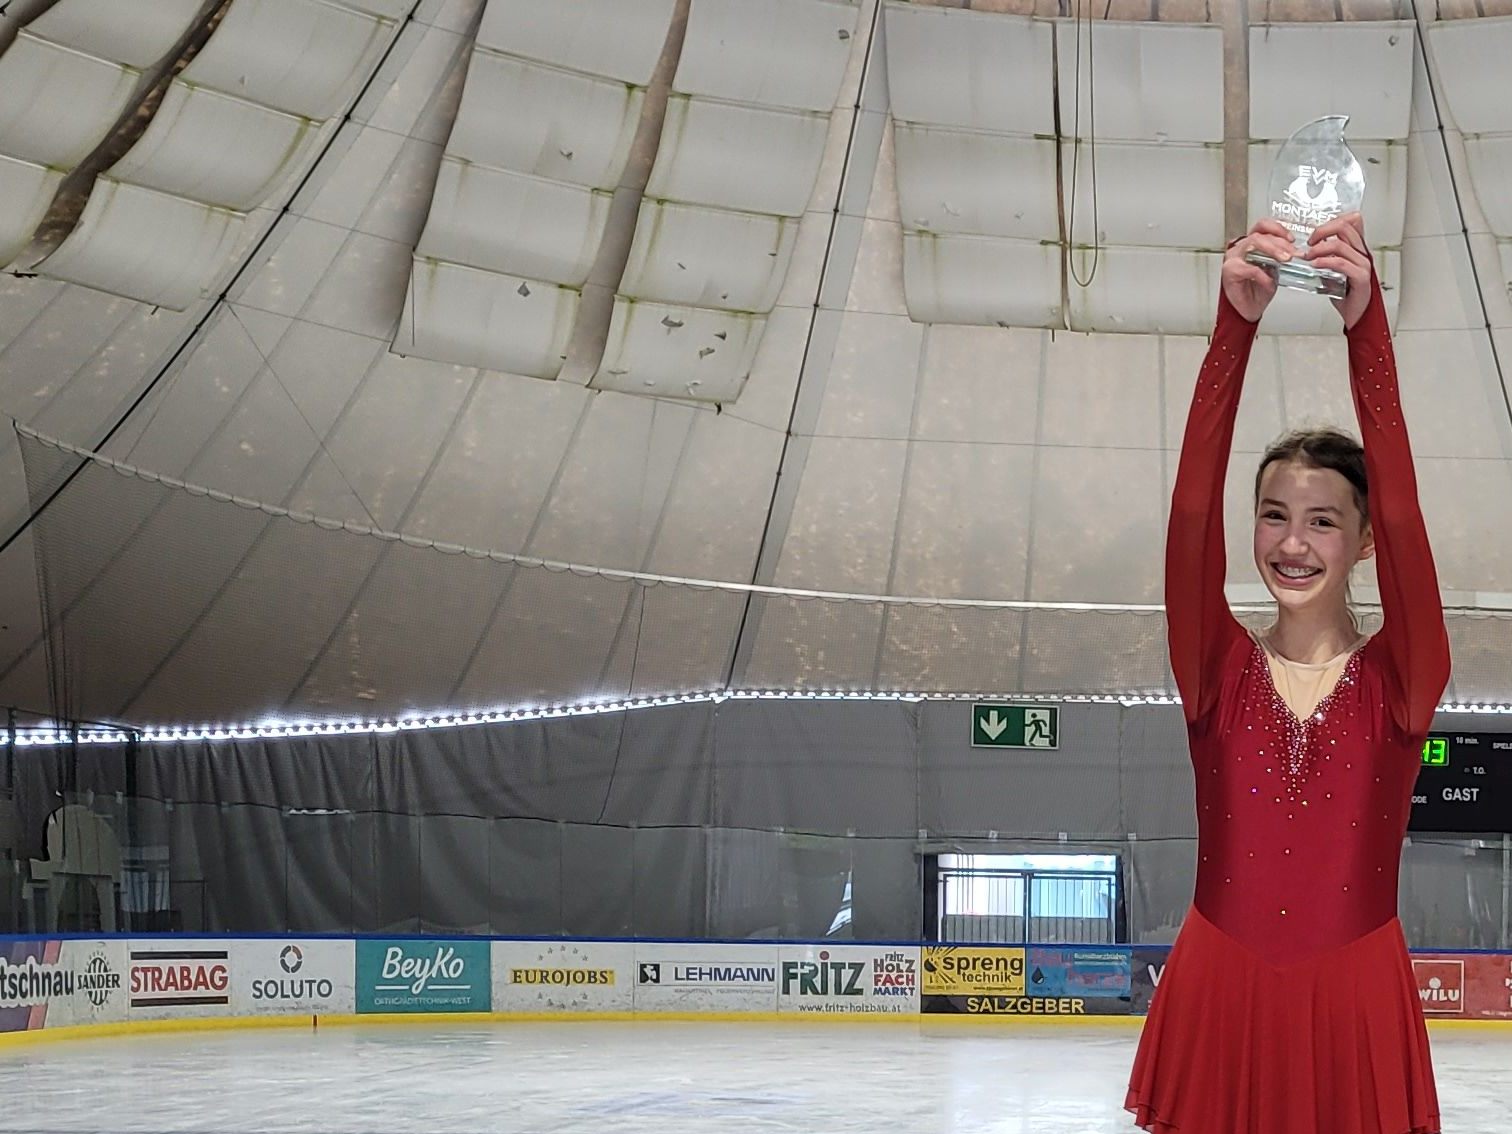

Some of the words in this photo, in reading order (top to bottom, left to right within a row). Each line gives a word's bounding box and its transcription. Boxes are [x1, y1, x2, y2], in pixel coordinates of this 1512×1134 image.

[1299, 165, 1338, 185] EVM
[1272, 201, 1337, 222] MONTAF
[1411, 795, 1427, 804] ODE
[1442, 788, 1479, 801] GAST
[382, 947, 464, 995] BeyKo
[873, 958, 915, 973] HOLZ
[942, 956, 1024, 976] spreng
[0, 964, 74, 1000] tschnau
[77, 974, 120, 990] SANDER
[131, 965, 228, 993] STRABAG
[512, 969, 609, 987] EUROJOBS
[675, 966, 776, 982] LEHMANN
[873, 974, 915, 986] FACH
[962, 972, 1012, 983] technik
[252, 979, 333, 999] SOLUTO
[873, 987, 915, 996] MARKT
[798, 1002, 901, 1013] www.fritz-holzbau.at
[967, 997, 1085, 1013] SALZGEBER
